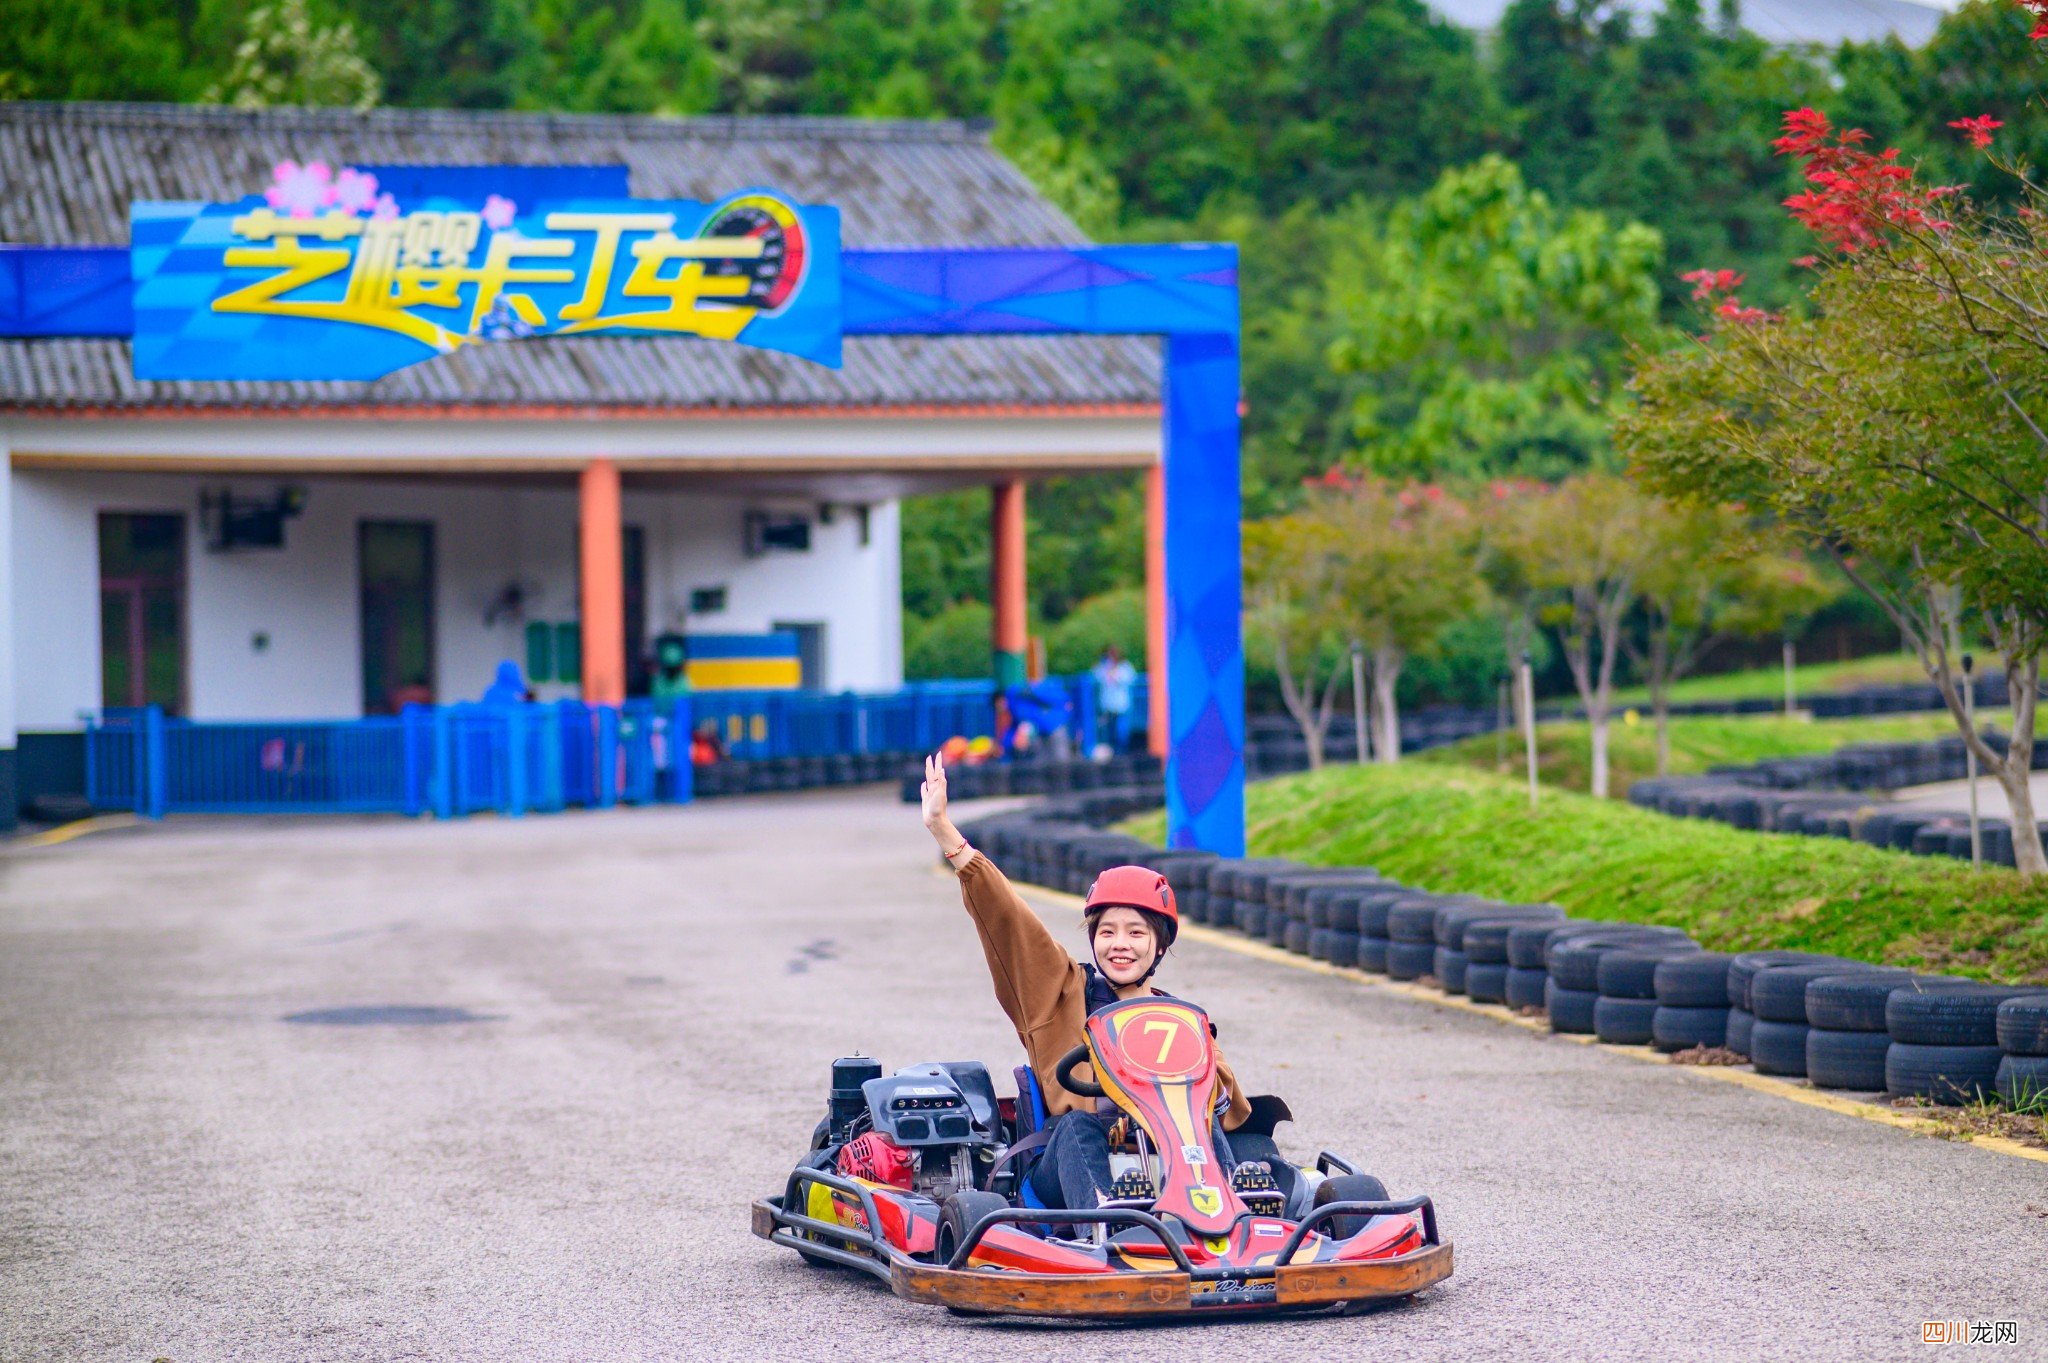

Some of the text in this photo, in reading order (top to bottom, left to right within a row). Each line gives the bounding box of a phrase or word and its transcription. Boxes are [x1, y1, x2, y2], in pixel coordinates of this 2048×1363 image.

[211, 208, 765, 352] 芝樱卡丁车
[1143, 1020, 1180, 1064] 7
